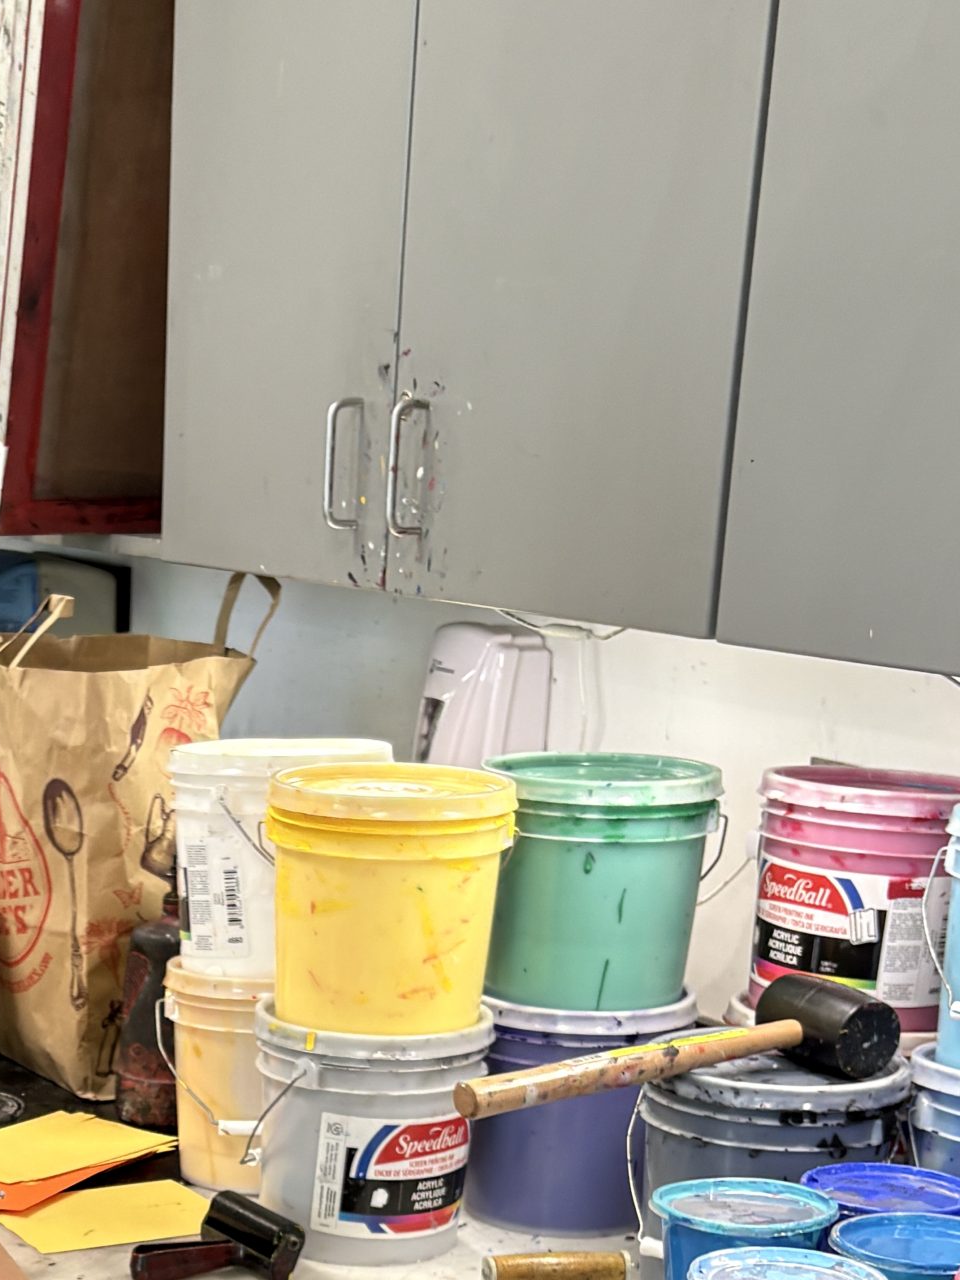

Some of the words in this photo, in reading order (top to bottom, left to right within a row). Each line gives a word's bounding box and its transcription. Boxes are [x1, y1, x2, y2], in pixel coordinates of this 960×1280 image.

[763, 873, 831, 908] Speedball
[772, 929, 800, 945] ACRYLIC
[768, 938, 803, 956] ACRYLIQUE
[395, 1125, 465, 1158] Speedball
[417, 1178, 444, 1191] ACRYLIC
[411, 1187, 447, 1201] ACRYLIQUE
